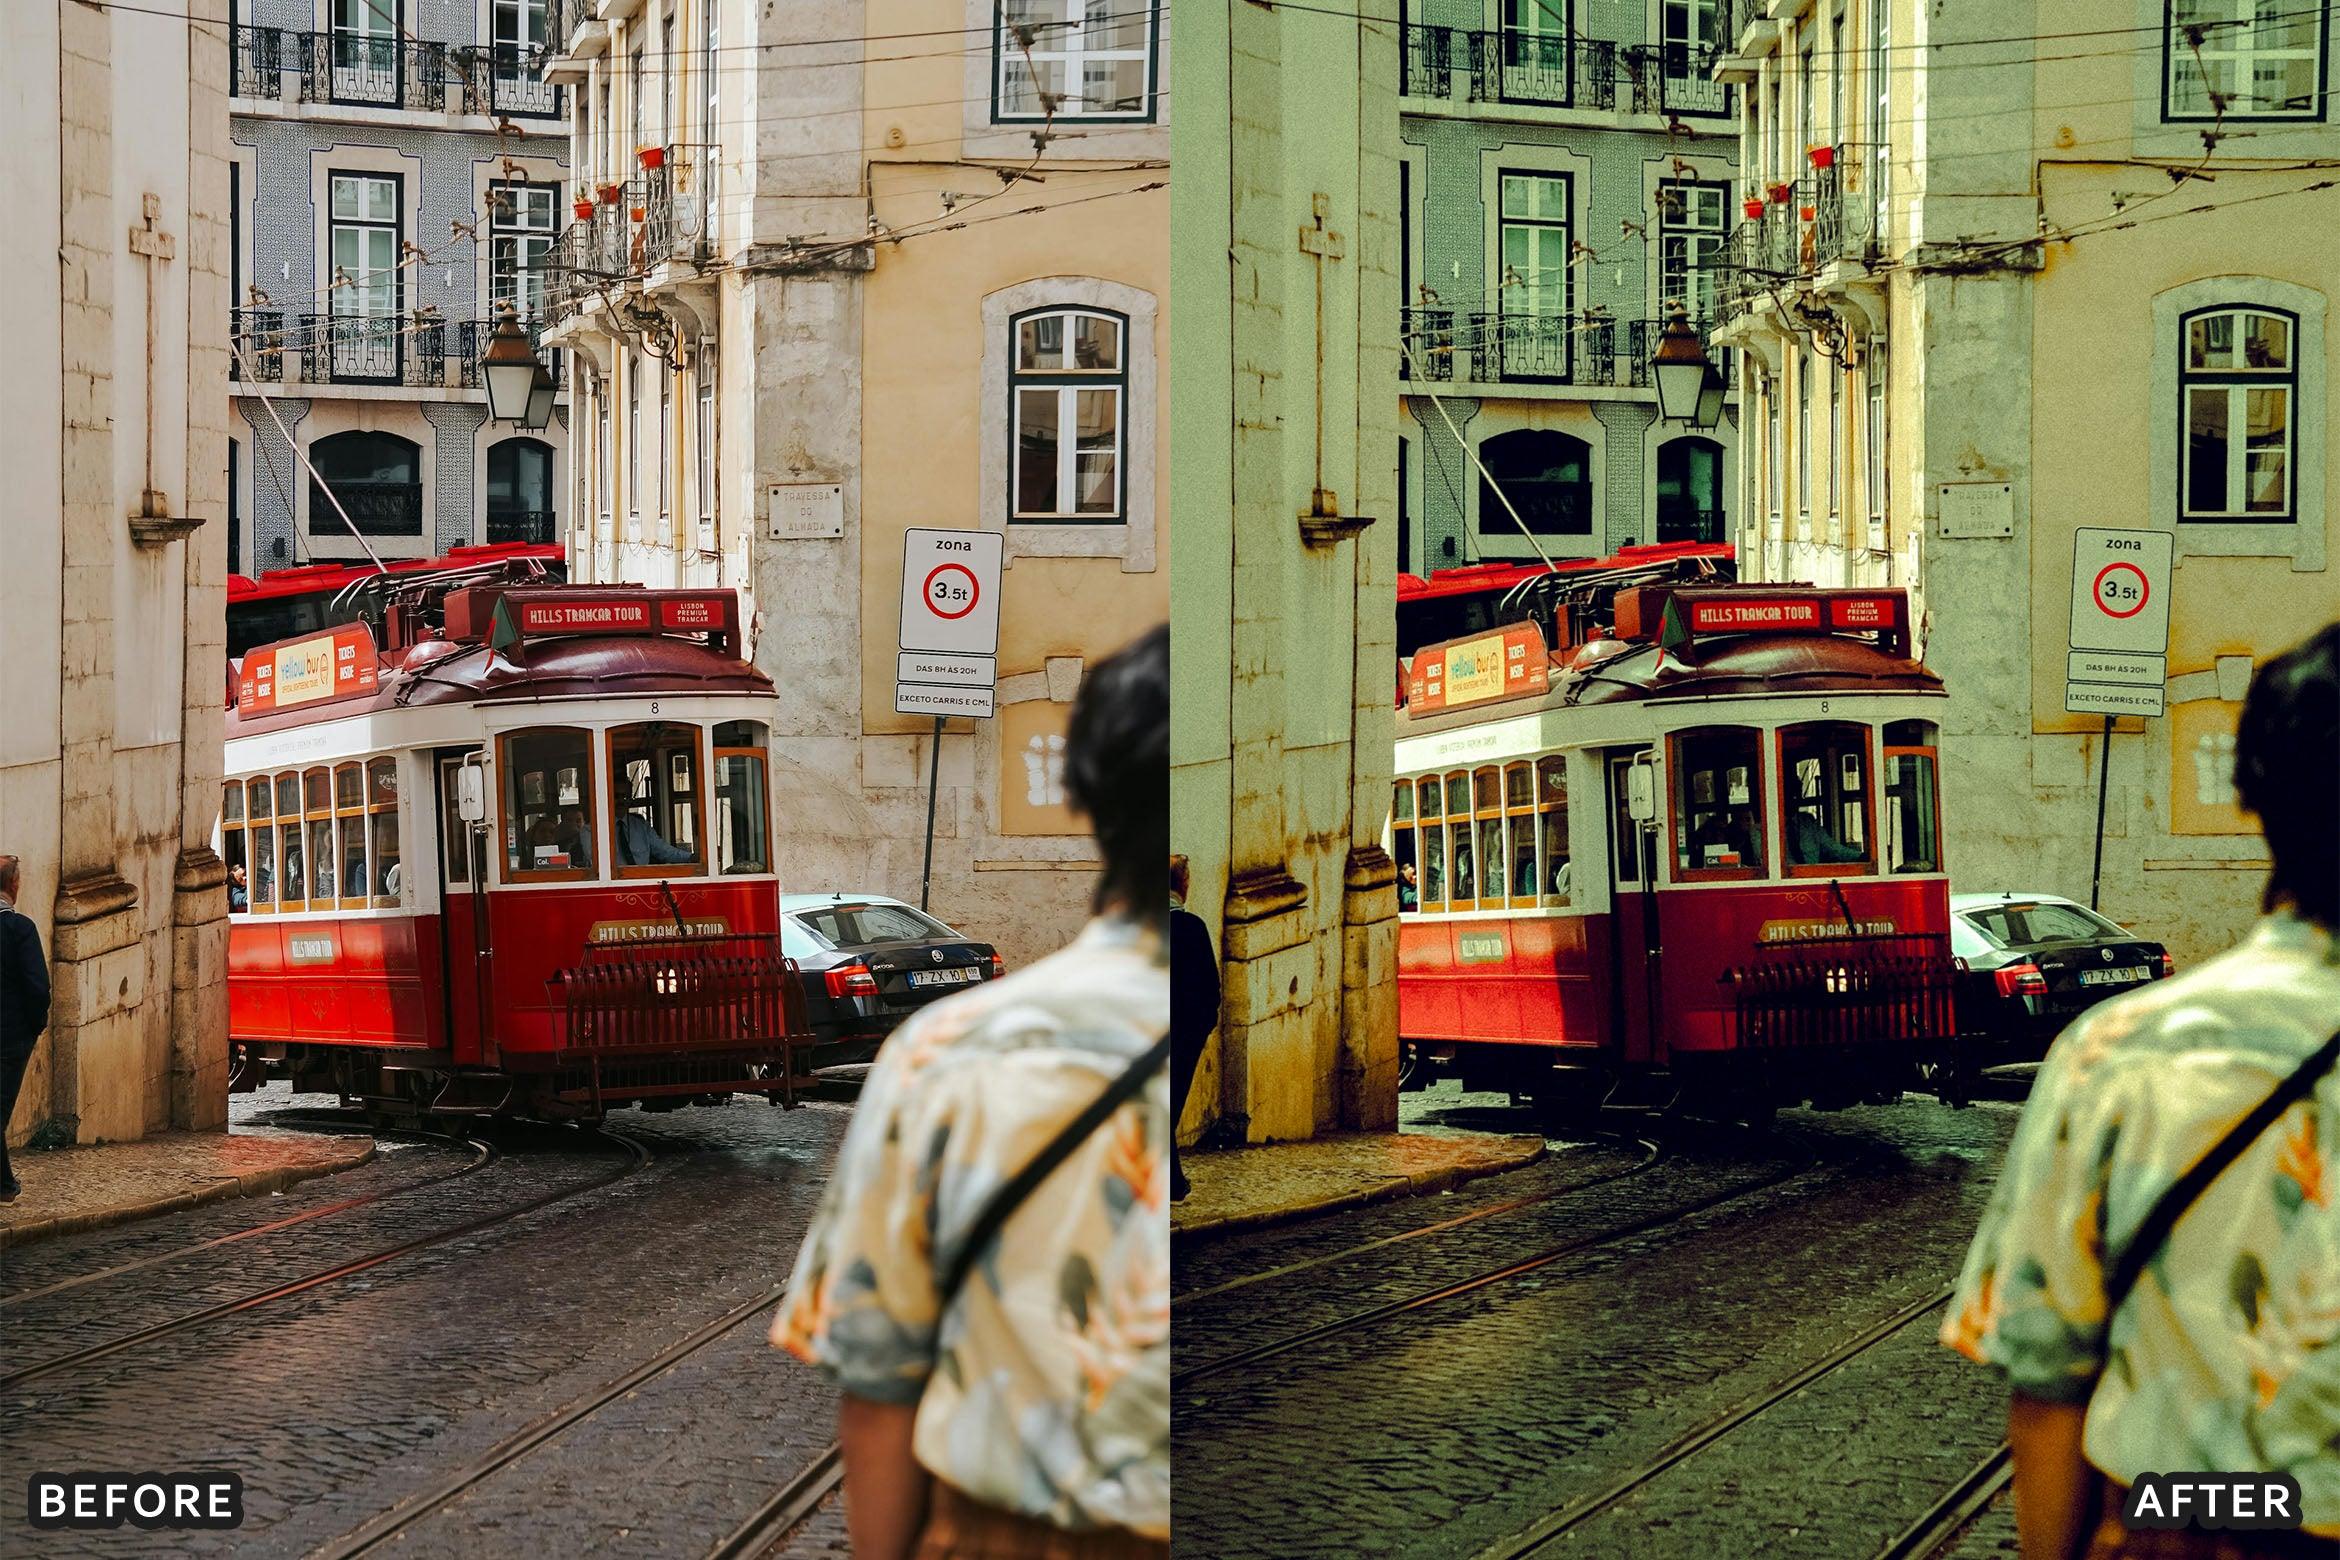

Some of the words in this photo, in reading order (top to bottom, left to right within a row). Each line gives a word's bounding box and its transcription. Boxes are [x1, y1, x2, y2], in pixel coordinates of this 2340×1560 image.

[935, 540, 972, 551] zona
[2105, 539, 2142, 550] zona
[934, 582, 968, 600] 3.5t
[2104, 581, 2138, 599] 3.5t
[530, 609, 563, 624] HILLS
[565, 608, 612, 622] TRAMCAR
[614, 607, 642, 621] TOUR
[1700, 608, 1733, 623] HILLS
[1735, 607, 1782, 621] TRAMCAR
[1784, 606, 1812, 620] TOUR
[916, 664, 933, 672] DAS
[934, 665, 946, 673] 8H
[960, 667, 977, 675] 20H
[2086, 663, 2103, 671] DAS
[2130, 666, 2147, 674] 20H
[899, 694, 931, 703] EXCETO
[932, 696, 963, 705] CARRIS
[965, 698, 971, 706] E
[972, 699, 990, 707] CML
[2069, 693, 2101, 702] EXCETO
[2102, 695, 2133, 704] CARRIS
[2135, 697, 2141, 705] E
[2142, 698, 2160, 706] CML
[651, 702, 659, 714] 8
[1821, 701, 1829, 713] 8
